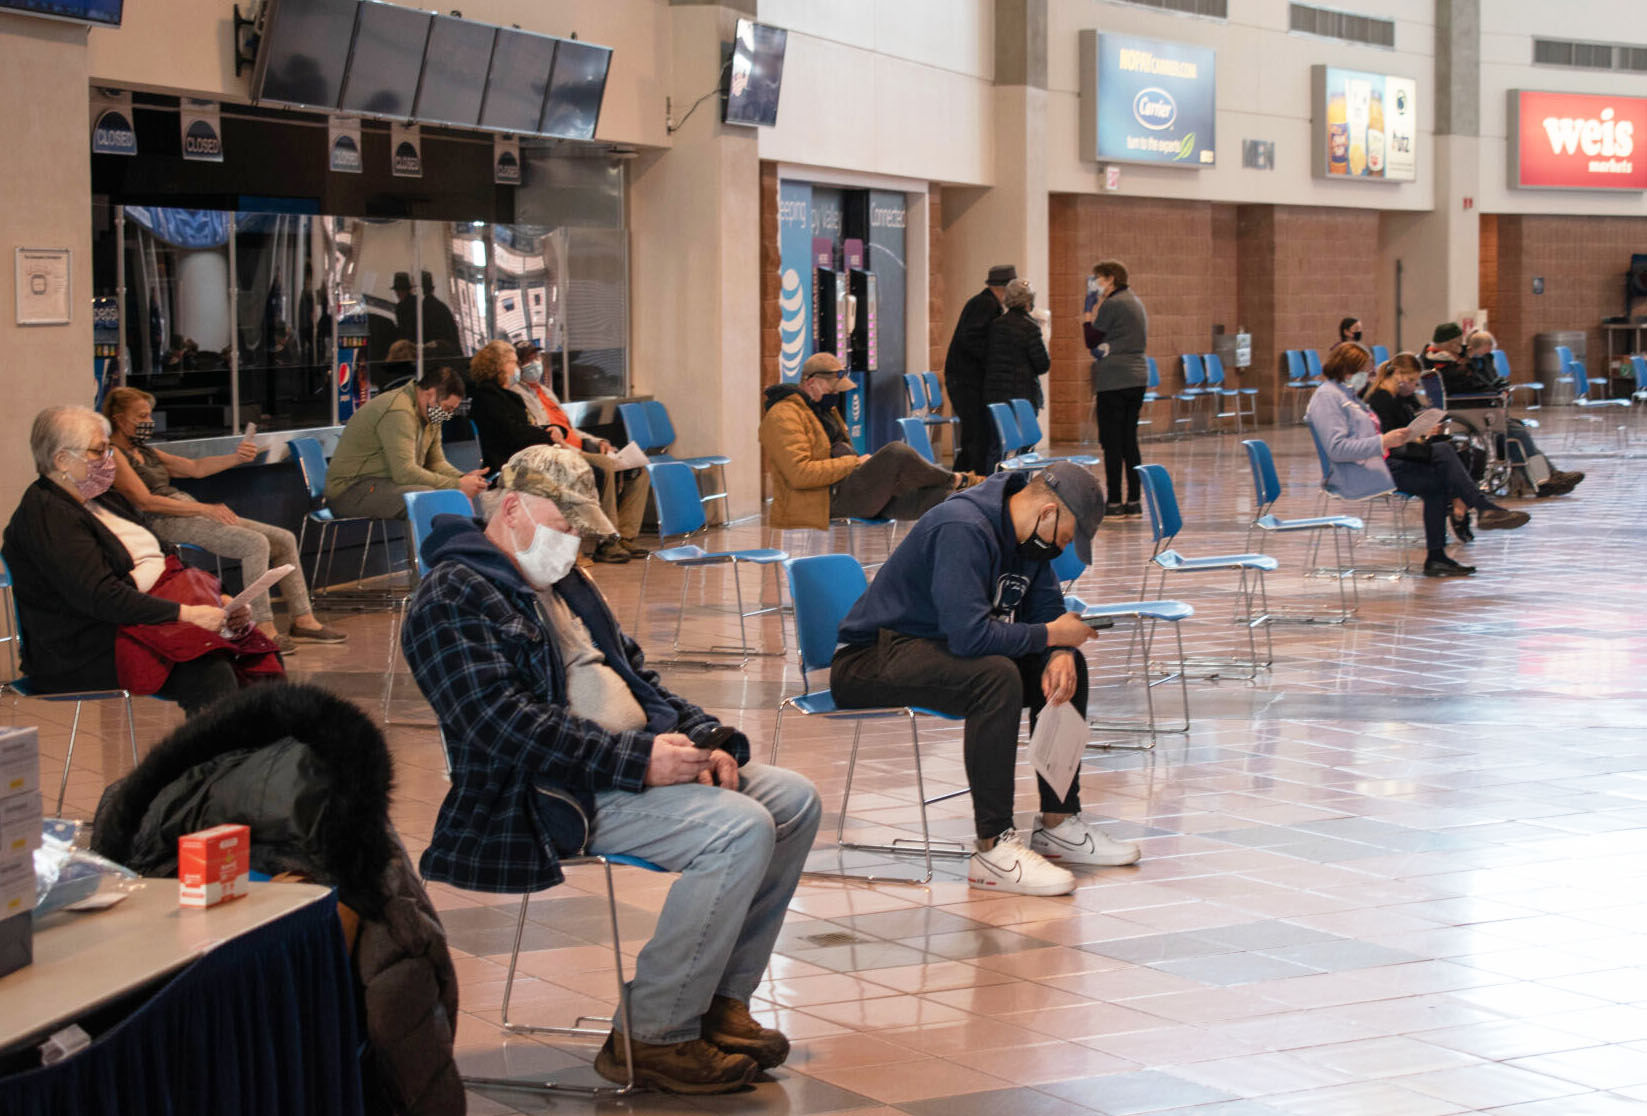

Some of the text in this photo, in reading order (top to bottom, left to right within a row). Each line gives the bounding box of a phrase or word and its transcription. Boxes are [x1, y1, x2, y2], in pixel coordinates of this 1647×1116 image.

[1138, 96, 1172, 118] Carrier
[97, 129, 133, 147] CLOSED
[1543, 107, 1634, 157] weis
[187, 137, 219, 154] CLOSED
[1588, 158, 1633, 174] markets
[780, 200, 807, 229] eeping
